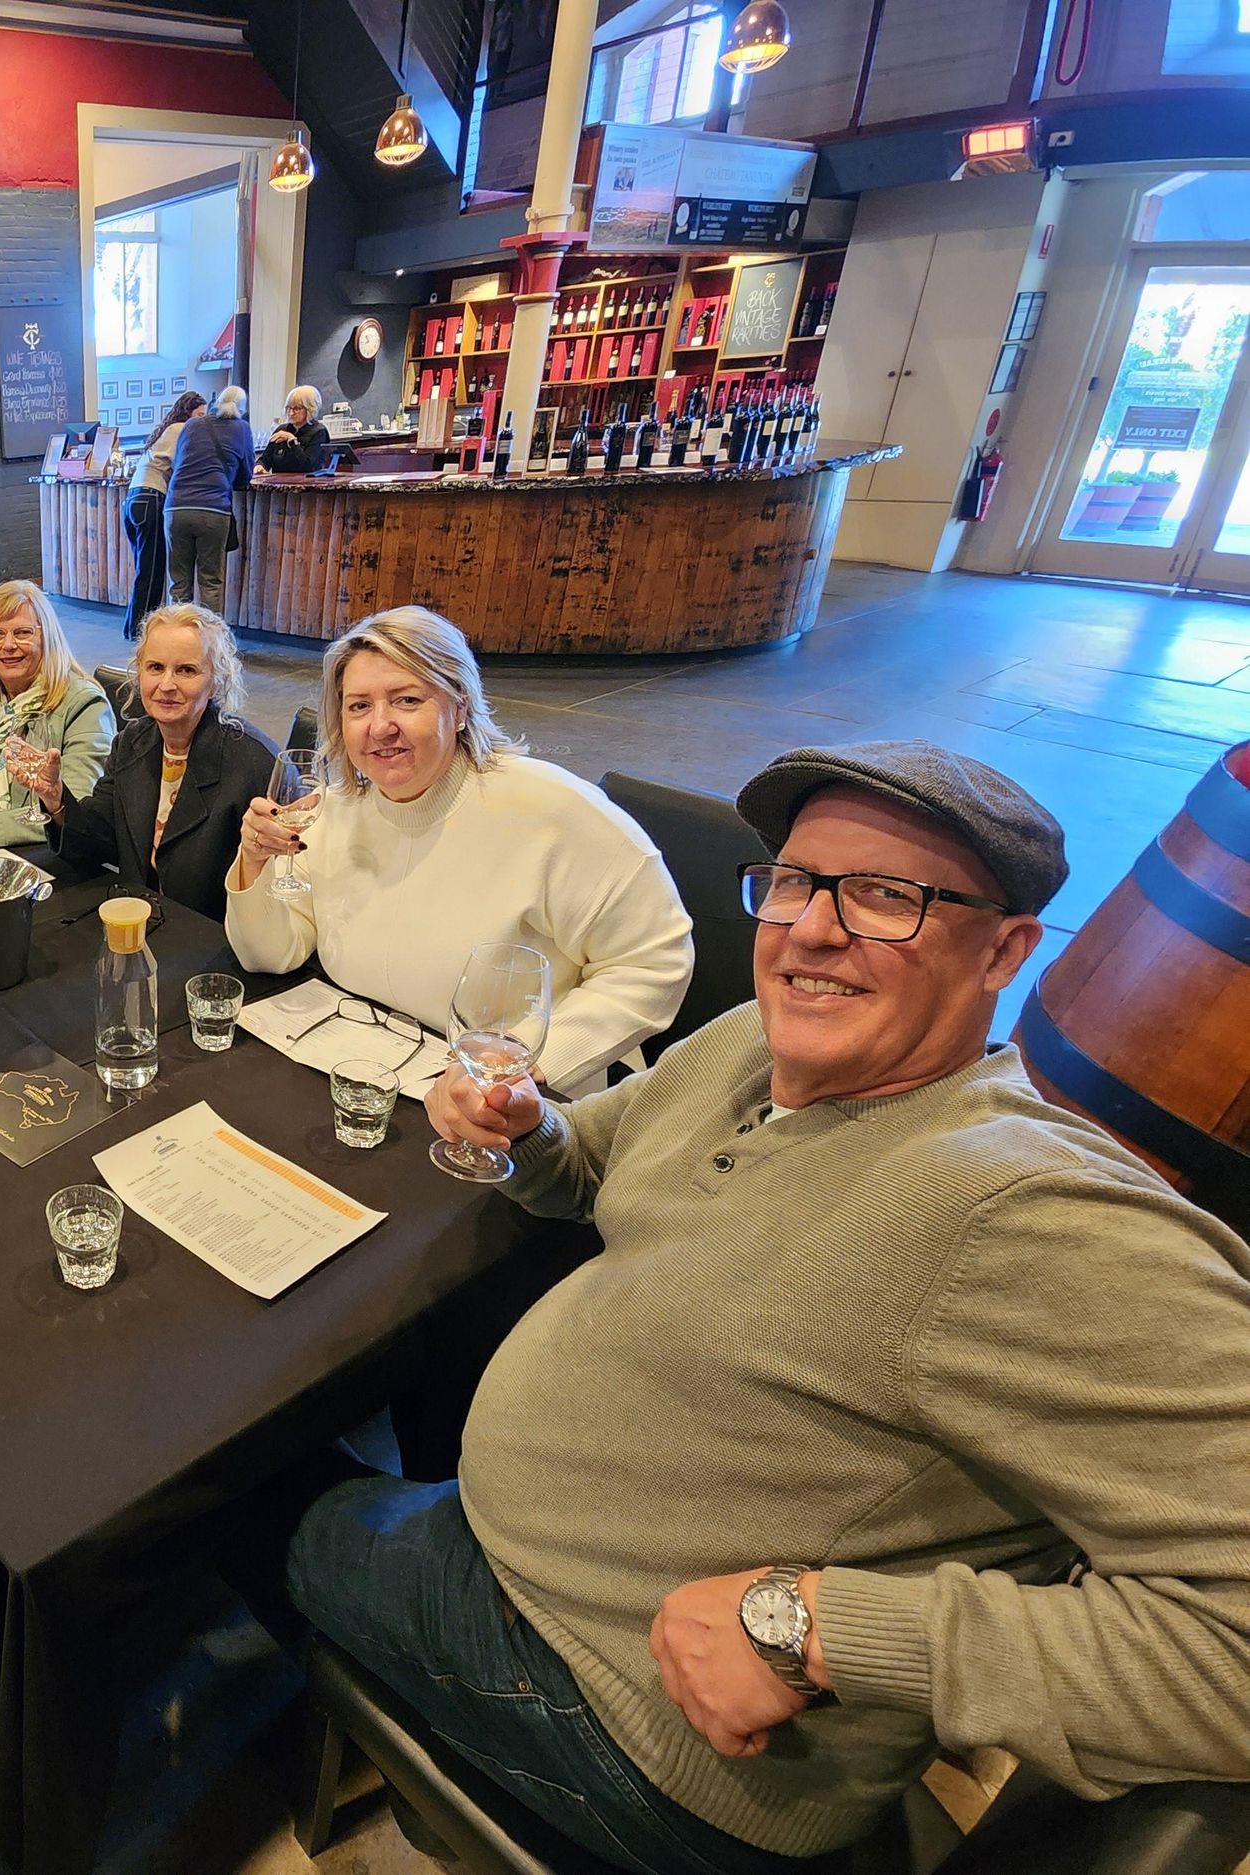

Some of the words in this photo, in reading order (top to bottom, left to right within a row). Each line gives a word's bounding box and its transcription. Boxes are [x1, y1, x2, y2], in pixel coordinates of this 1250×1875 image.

[747, 288, 782, 309] BACK
[735, 308, 782, 326] VINTAGE
[731, 323, 781, 346] RARITIES
